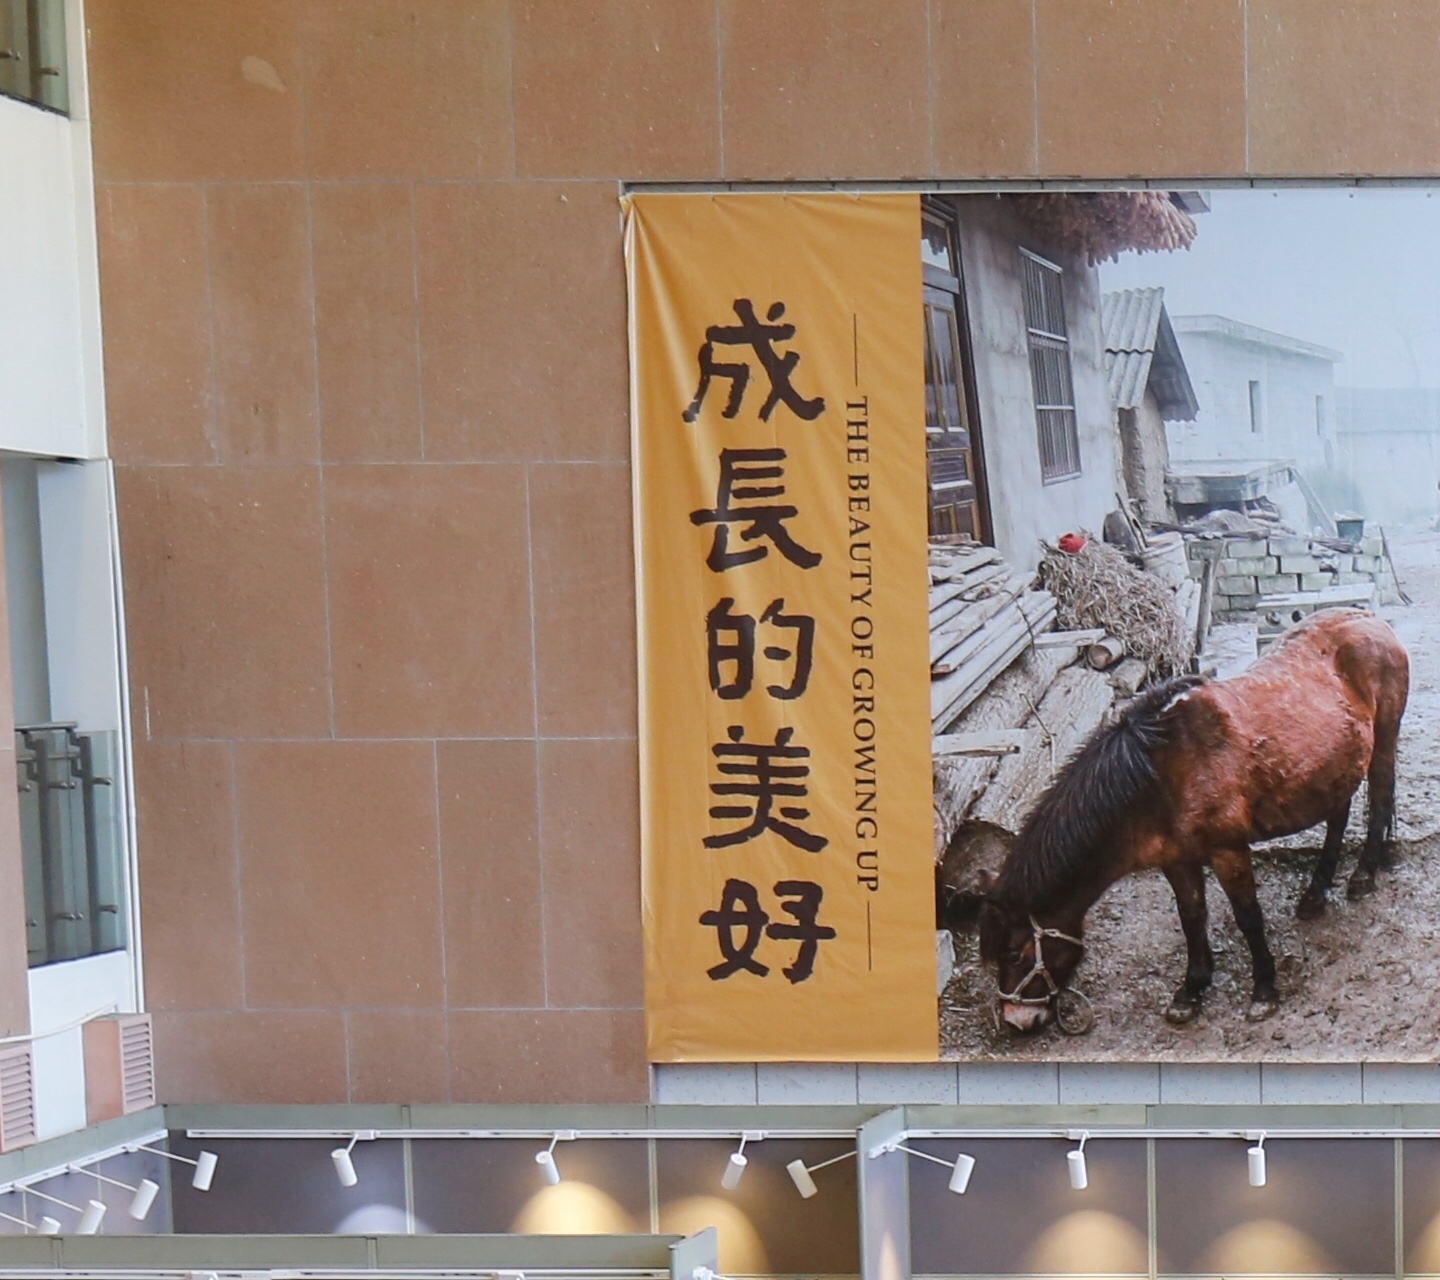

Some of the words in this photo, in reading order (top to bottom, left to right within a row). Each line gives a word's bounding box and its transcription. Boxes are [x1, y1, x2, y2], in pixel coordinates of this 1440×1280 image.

[846, 395, 869, 465] THE
[847, 473, 872, 607] BEAUTY
[681, 297, 838, 986] 成長的美好
[850, 615, 874, 660] OF
[852, 667, 879, 840] GROWING
[856, 850, 880, 892] UP
